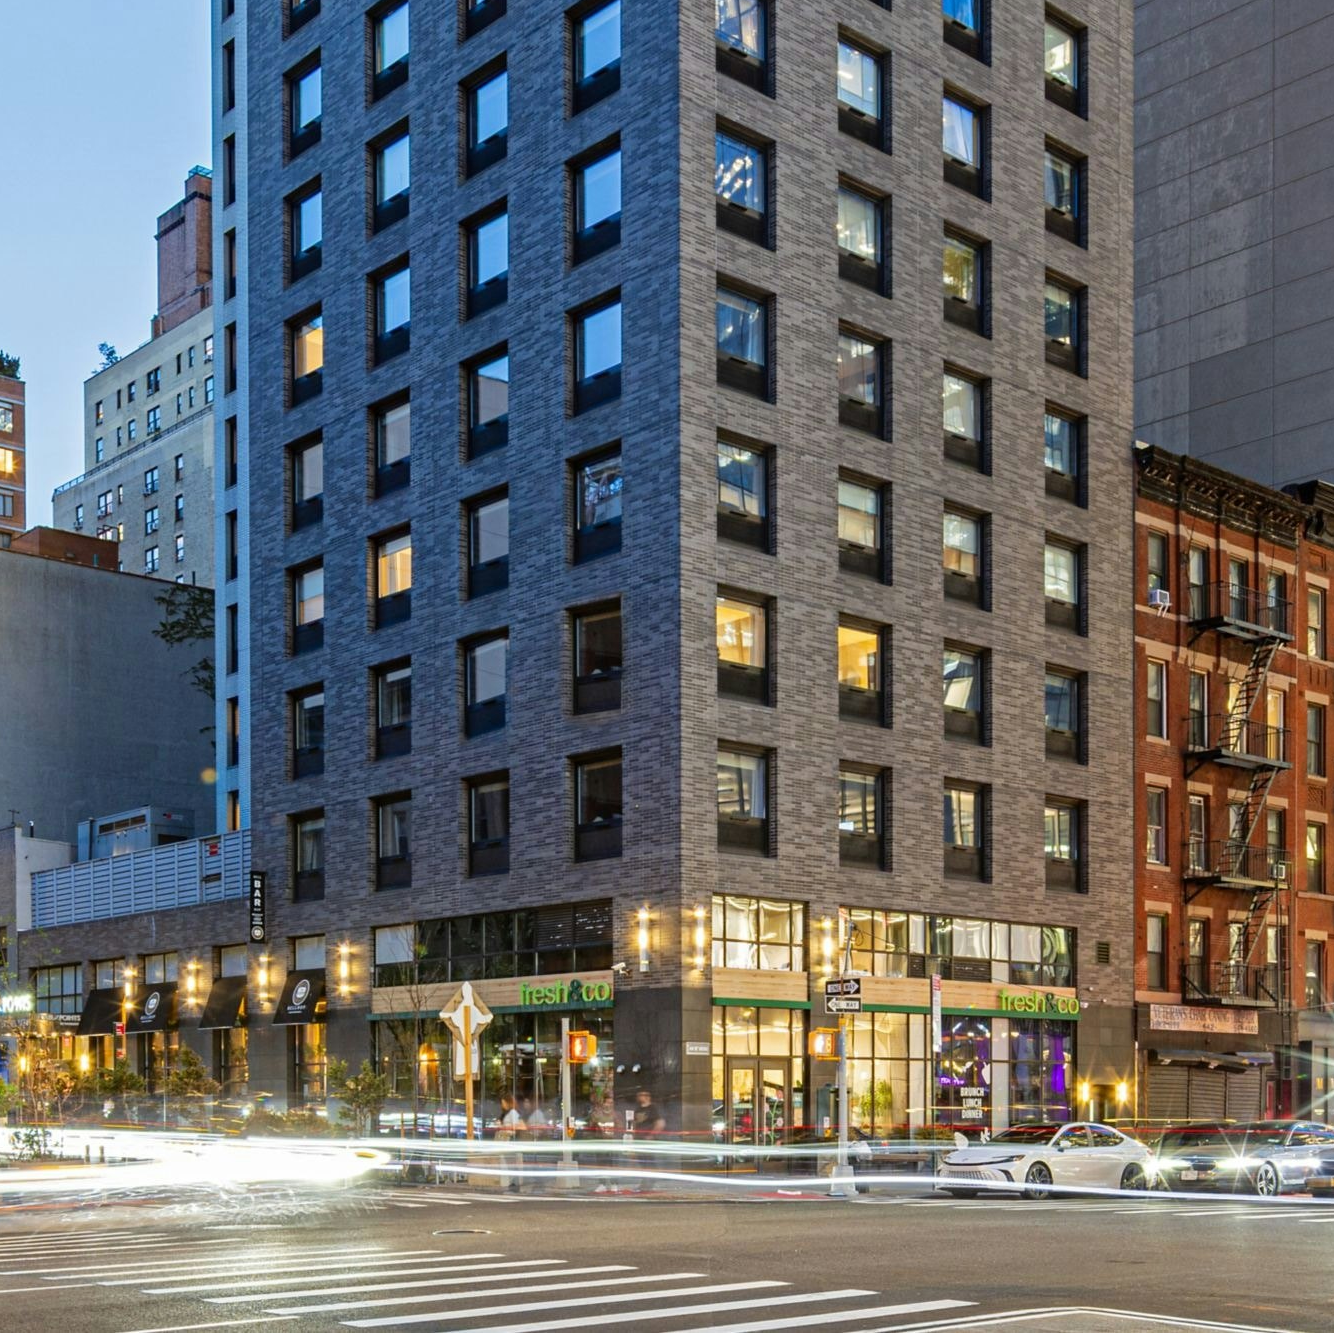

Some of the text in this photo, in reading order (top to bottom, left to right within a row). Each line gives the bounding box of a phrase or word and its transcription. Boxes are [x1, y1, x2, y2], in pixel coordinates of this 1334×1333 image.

[253, 879, 262, 907] BAR
[520, 979, 611, 1006] fresh&co
[999, 988, 1080, 1014] fresh&co
[960, 1087, 985, 1097] BRUNCH
[962, 1098, 983, 1108] LUNCH
[961, 1109, 983, 1119] DINNER
